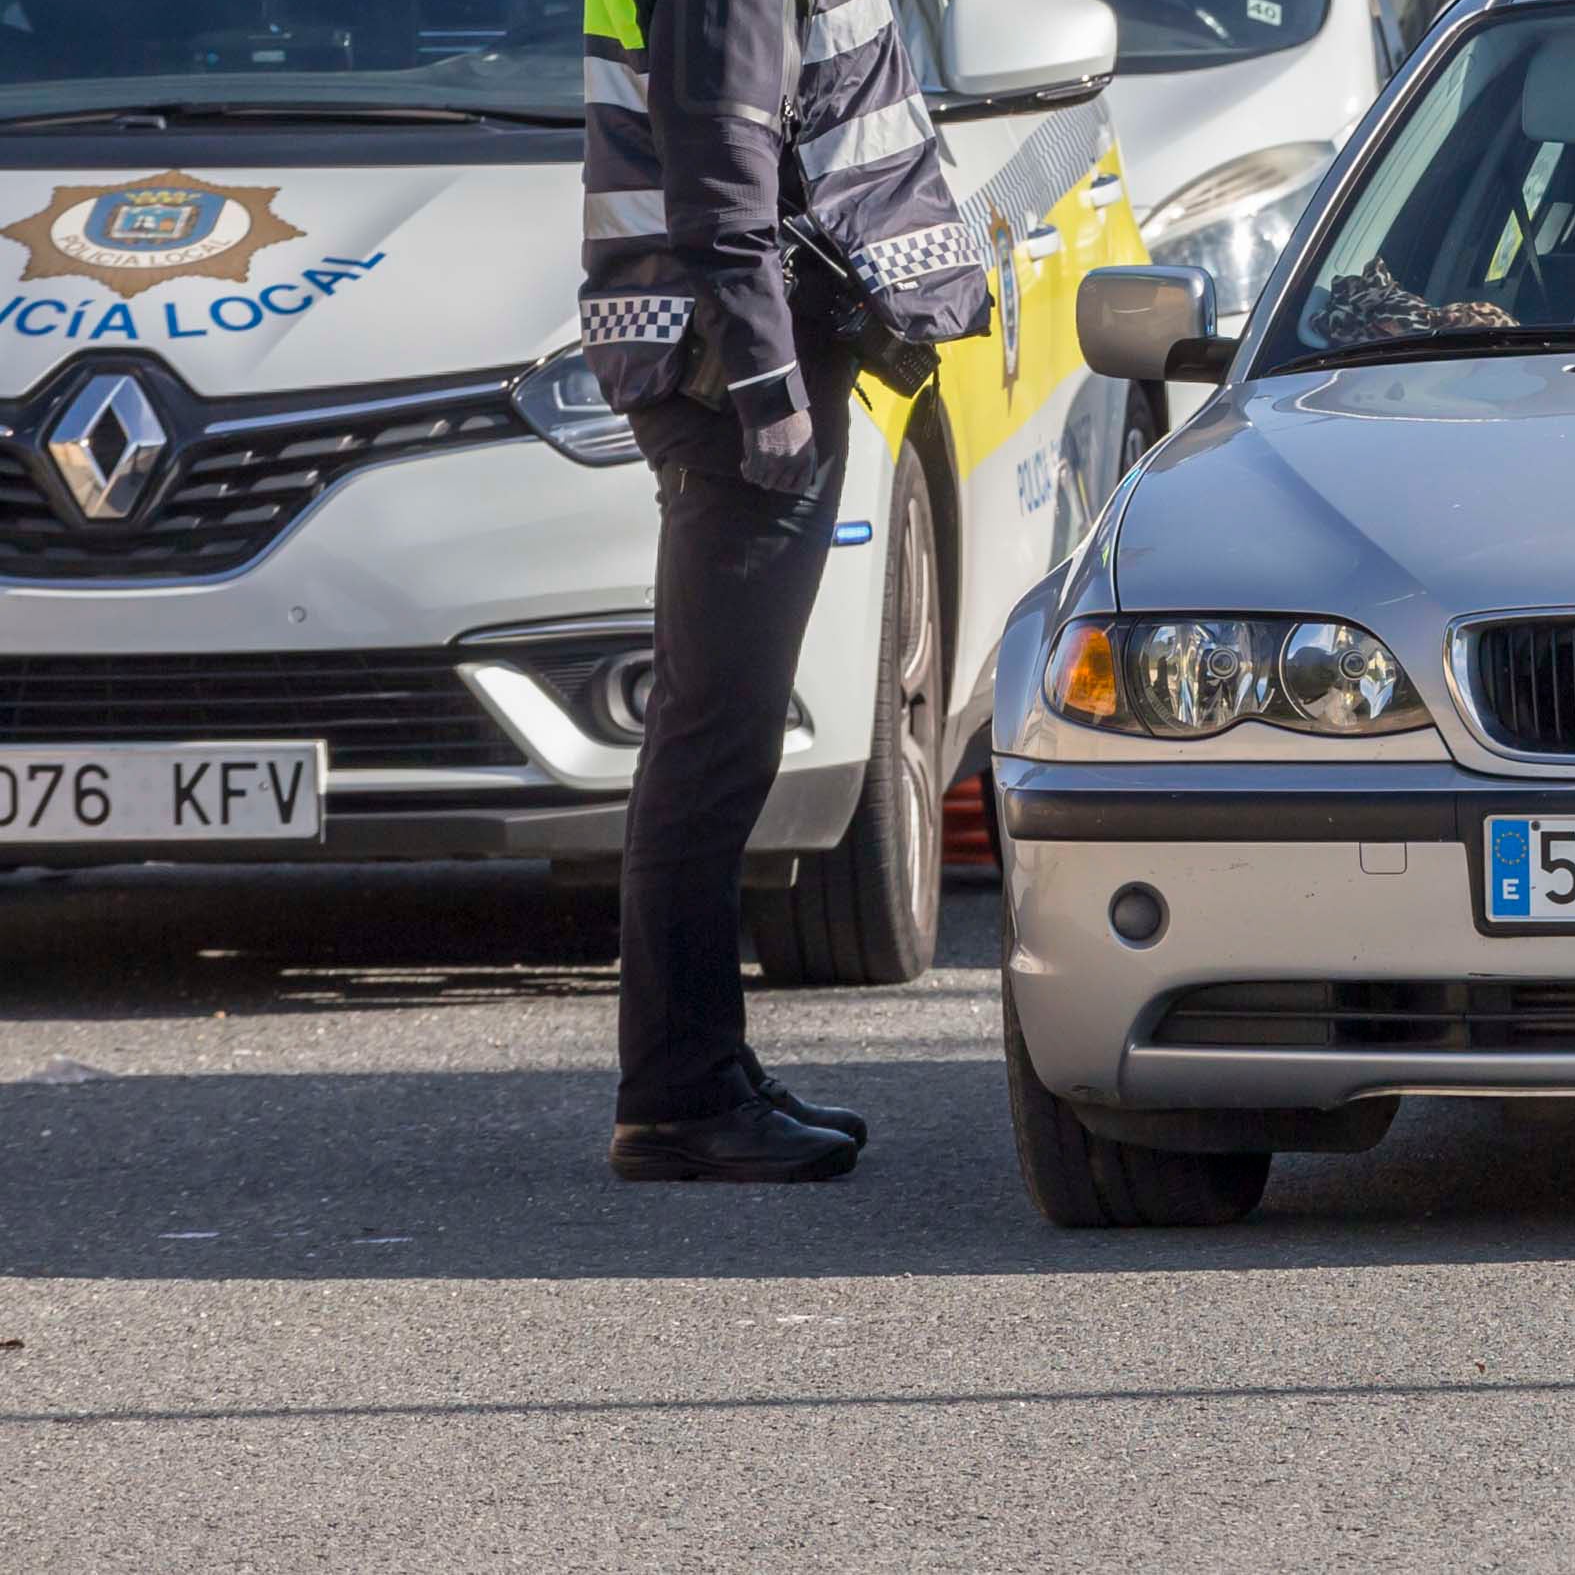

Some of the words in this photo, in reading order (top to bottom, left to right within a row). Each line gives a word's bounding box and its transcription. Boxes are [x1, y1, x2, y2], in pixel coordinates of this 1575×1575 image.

[151, 239, 231, 266] LOCAL
[164, 252, 386, 339] LOCAL
[174, 761, 304, 826] KFV
[1502, 878, 1520, 901] E
